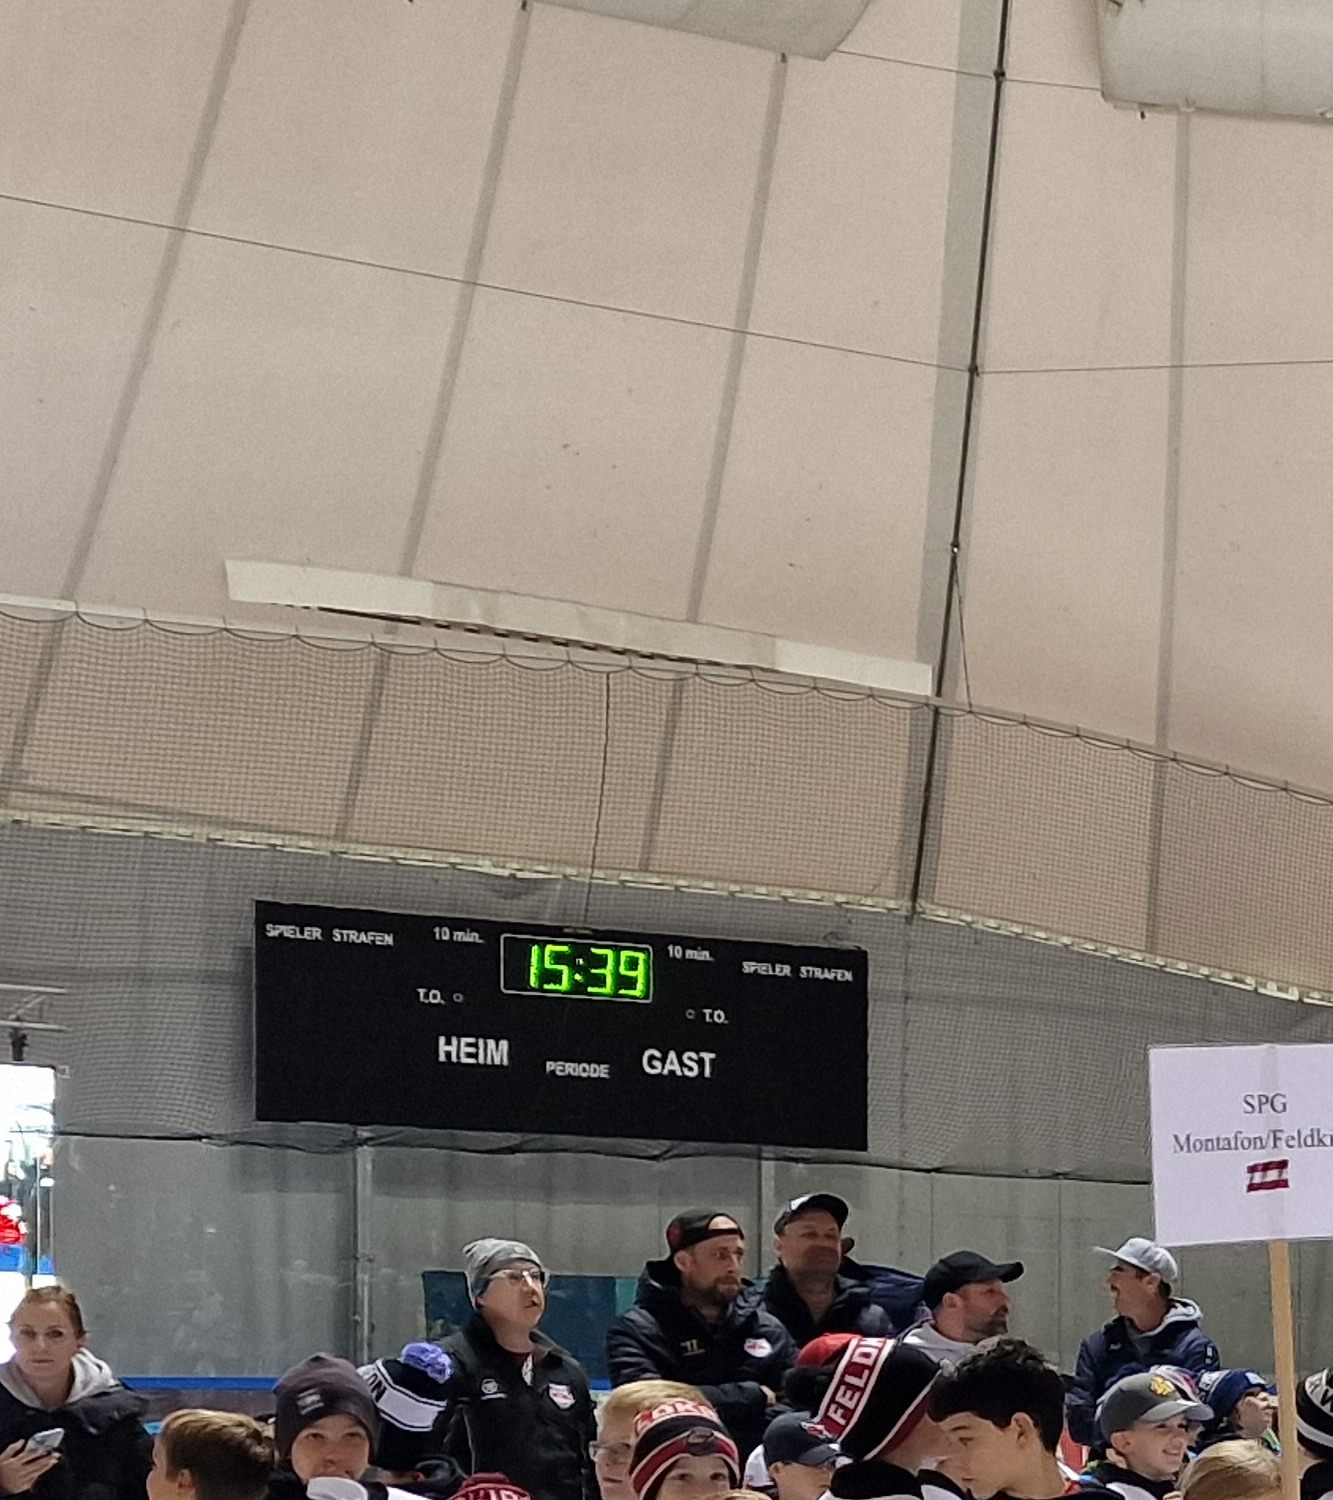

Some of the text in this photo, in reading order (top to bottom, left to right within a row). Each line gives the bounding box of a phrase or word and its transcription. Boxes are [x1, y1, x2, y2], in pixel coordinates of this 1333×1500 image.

[265, 923, 394, 946] SPIELER STRAFEN
[433, 926, 485, 944] 10 min.
[667, 943, 714, 961] 10 min.
[529, 944, 649, 998] 15:39
[742, 961, 853, 982] SPIELER STRAFEN
[417, 987, 446, 1004] T.O.
[703, 1009, 729, 1025] T.O.
[437, 1036, 509, 1067] HEIM
[545, 1061, 611, 1079] PERIODE
[642, 1049, 717, 1078] GAST
[1243, 1093, 1288, 1114] SPG
